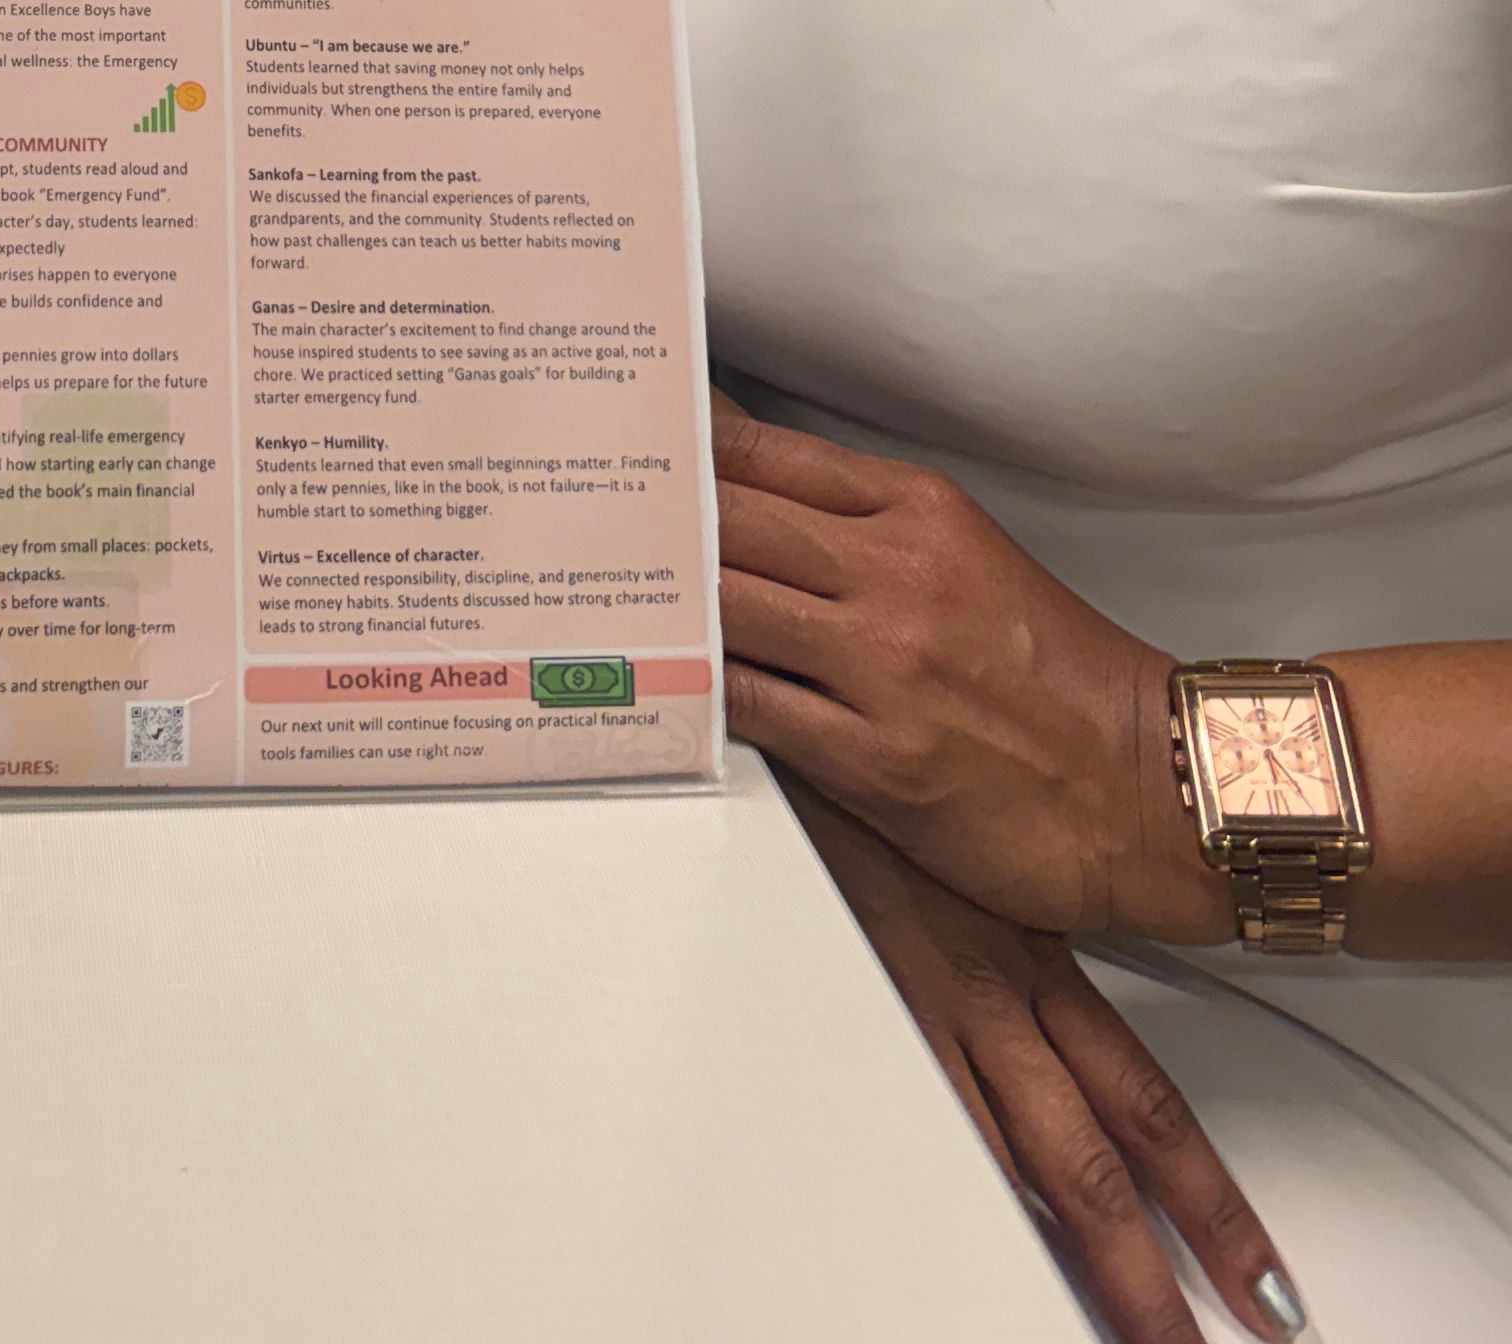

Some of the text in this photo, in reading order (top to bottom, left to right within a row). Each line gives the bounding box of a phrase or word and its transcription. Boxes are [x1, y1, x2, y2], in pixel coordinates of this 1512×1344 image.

[11, 3, 80, 16] Excellence
[84, 4, 116, 19] Boys
[120, 3, 151, 16] have
[17, 28, 31, 41] of
[34, 28, 57, 42] the
[61, 30, 95, 42] most
[99, 29, 166, 44] important
[246, 38, 296, 52] Ubuntu
[313, 38, 324, 52] "I
[328, 42, 348, 52] am
[353, 39, 408, 53] because
[412, 44, 432, 53] we
[77, 54, 99, 67] the
[104, 55, 178, 70] Emergency
[249, 168, 304, 181] Sankofa
[320, 168, 379, 184] Learning
[382, 168, 416, 182] from
[420, 168, 444, 182] the
[448, 170, 481, 184] past.
[38, 268, 90, 284] happen
[94, 269, 109, 281] to
[113, 270, 176, 284] everyone
[252, 300, 295, 314] Ganas
[311, 300, 355, 314] Desire
[360, 300, 386, 314] and
[390, 300, 494, 314] determination.
[252, 322, 656, 339] The main character's excitement to find change around the
[50, 429, 104, 444] real-life
[107, 432, 185, 446] emergency
[256, 436, 307, 452] Kenkyo
[324, 435, 388, 452] Humility.
[258, 550, 300, 564] Virtus
[317, 549, 391, 564] Excellence
[395, 548, 410, 562] of
[414, 548, 484, 562] character.
[12, 594, 58, 609] before
[325, 665, 509, 693] Looking Ahead
[261, 710, 658, 734] Our next unit will continue focusing on practical financial
